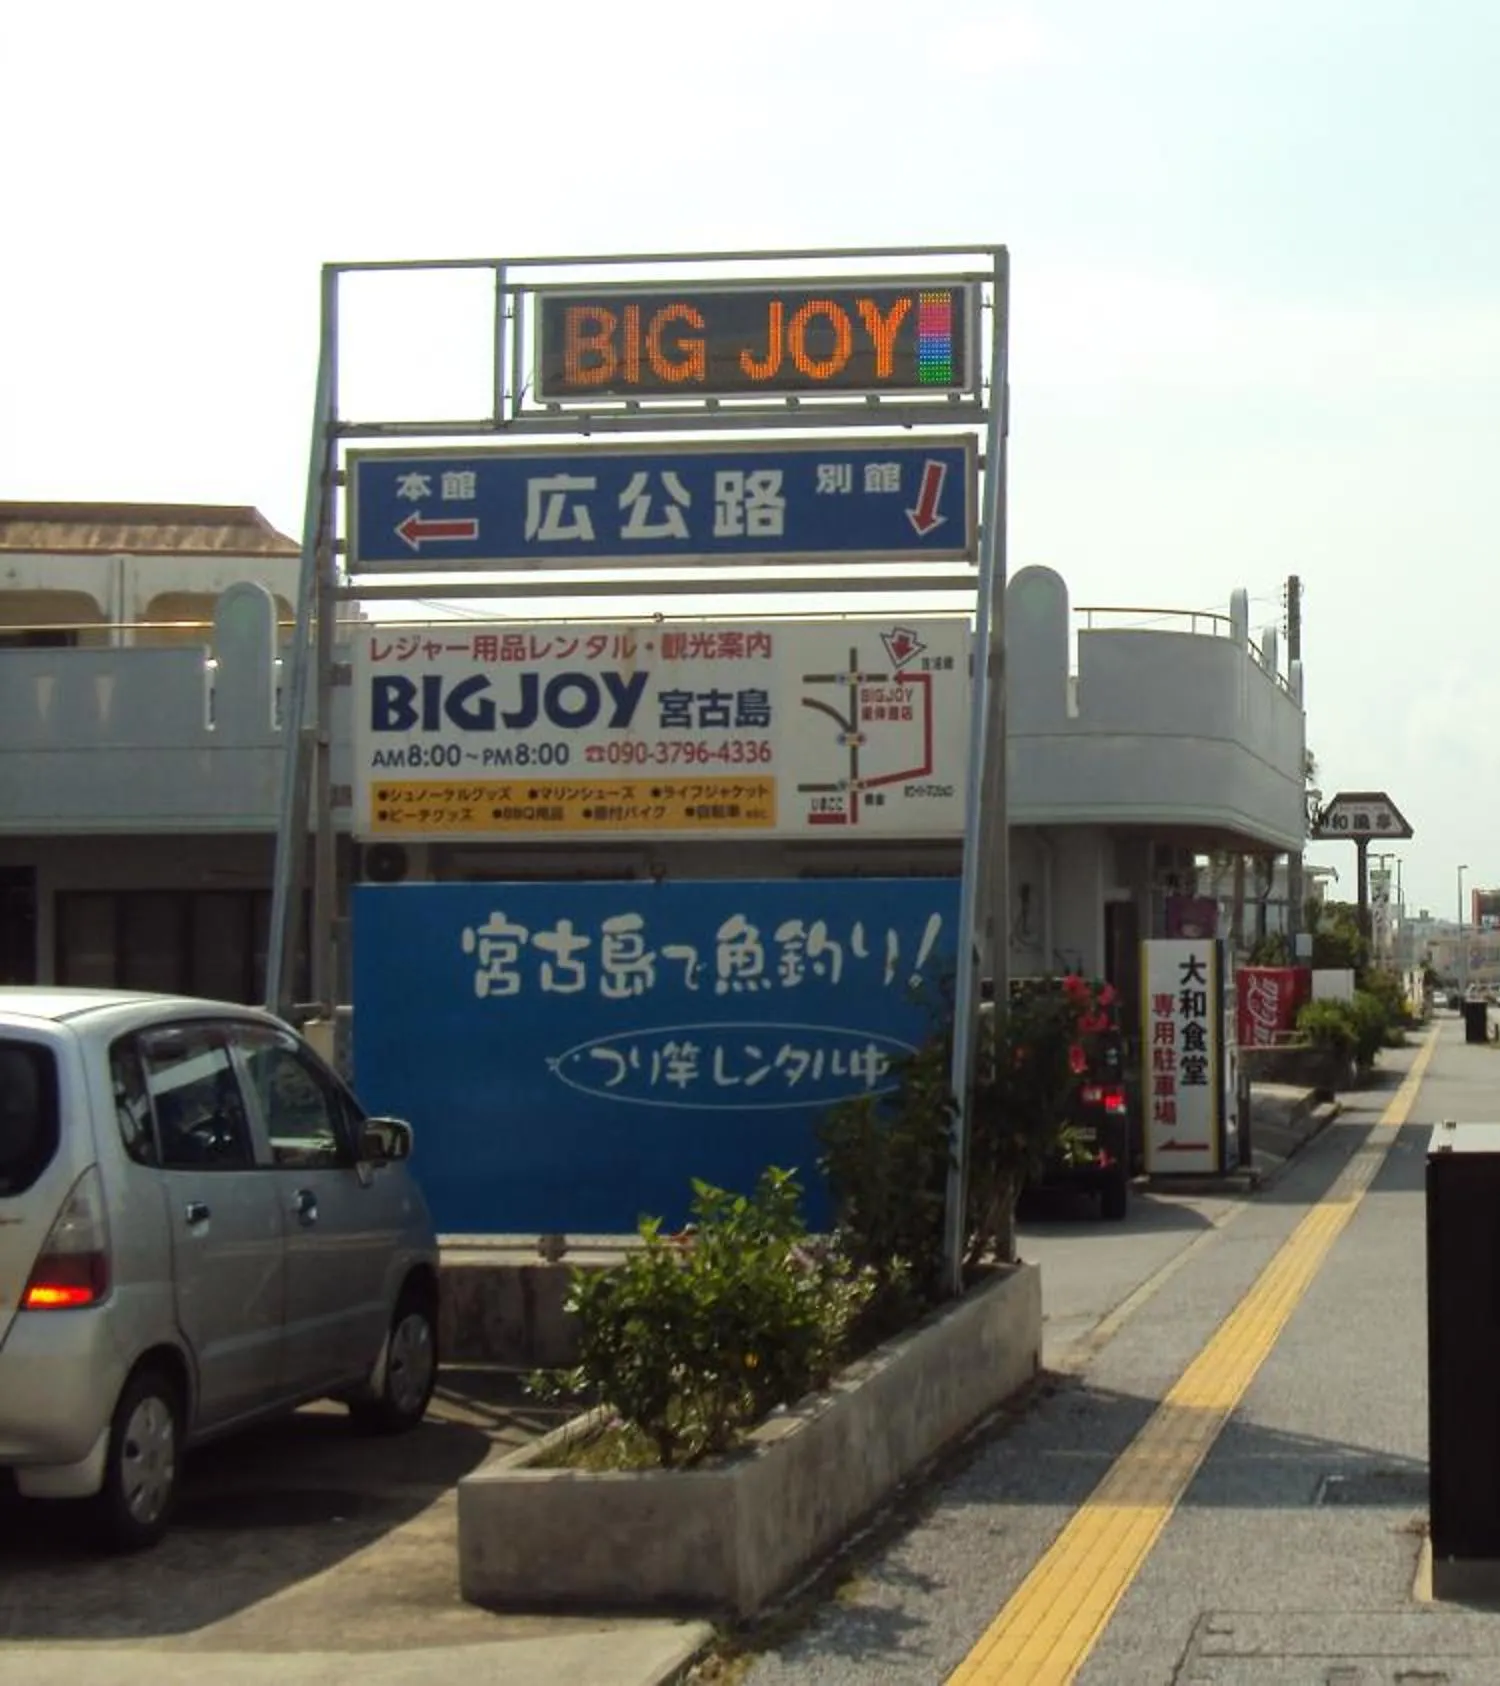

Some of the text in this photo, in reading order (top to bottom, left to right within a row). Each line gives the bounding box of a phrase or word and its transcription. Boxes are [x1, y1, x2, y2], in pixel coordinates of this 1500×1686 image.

[563, 296, 912, 387] BIG JOY
[396, 470, 477, 502] 本館
[524, 469, 786, 543] 広公路
[816, 462, 902, 495] 別館
[370, 632, 773, 662] レジャー用品レンタル・観光案内
[371, 671, 772, 732] BIGJOY 宮古島
[607, 740, 773, 765] 090-3796-4336
[1178, 953, 1209, 1087] 大和食堂
[1153, 992, 1178, 1127] 専用駐車場
